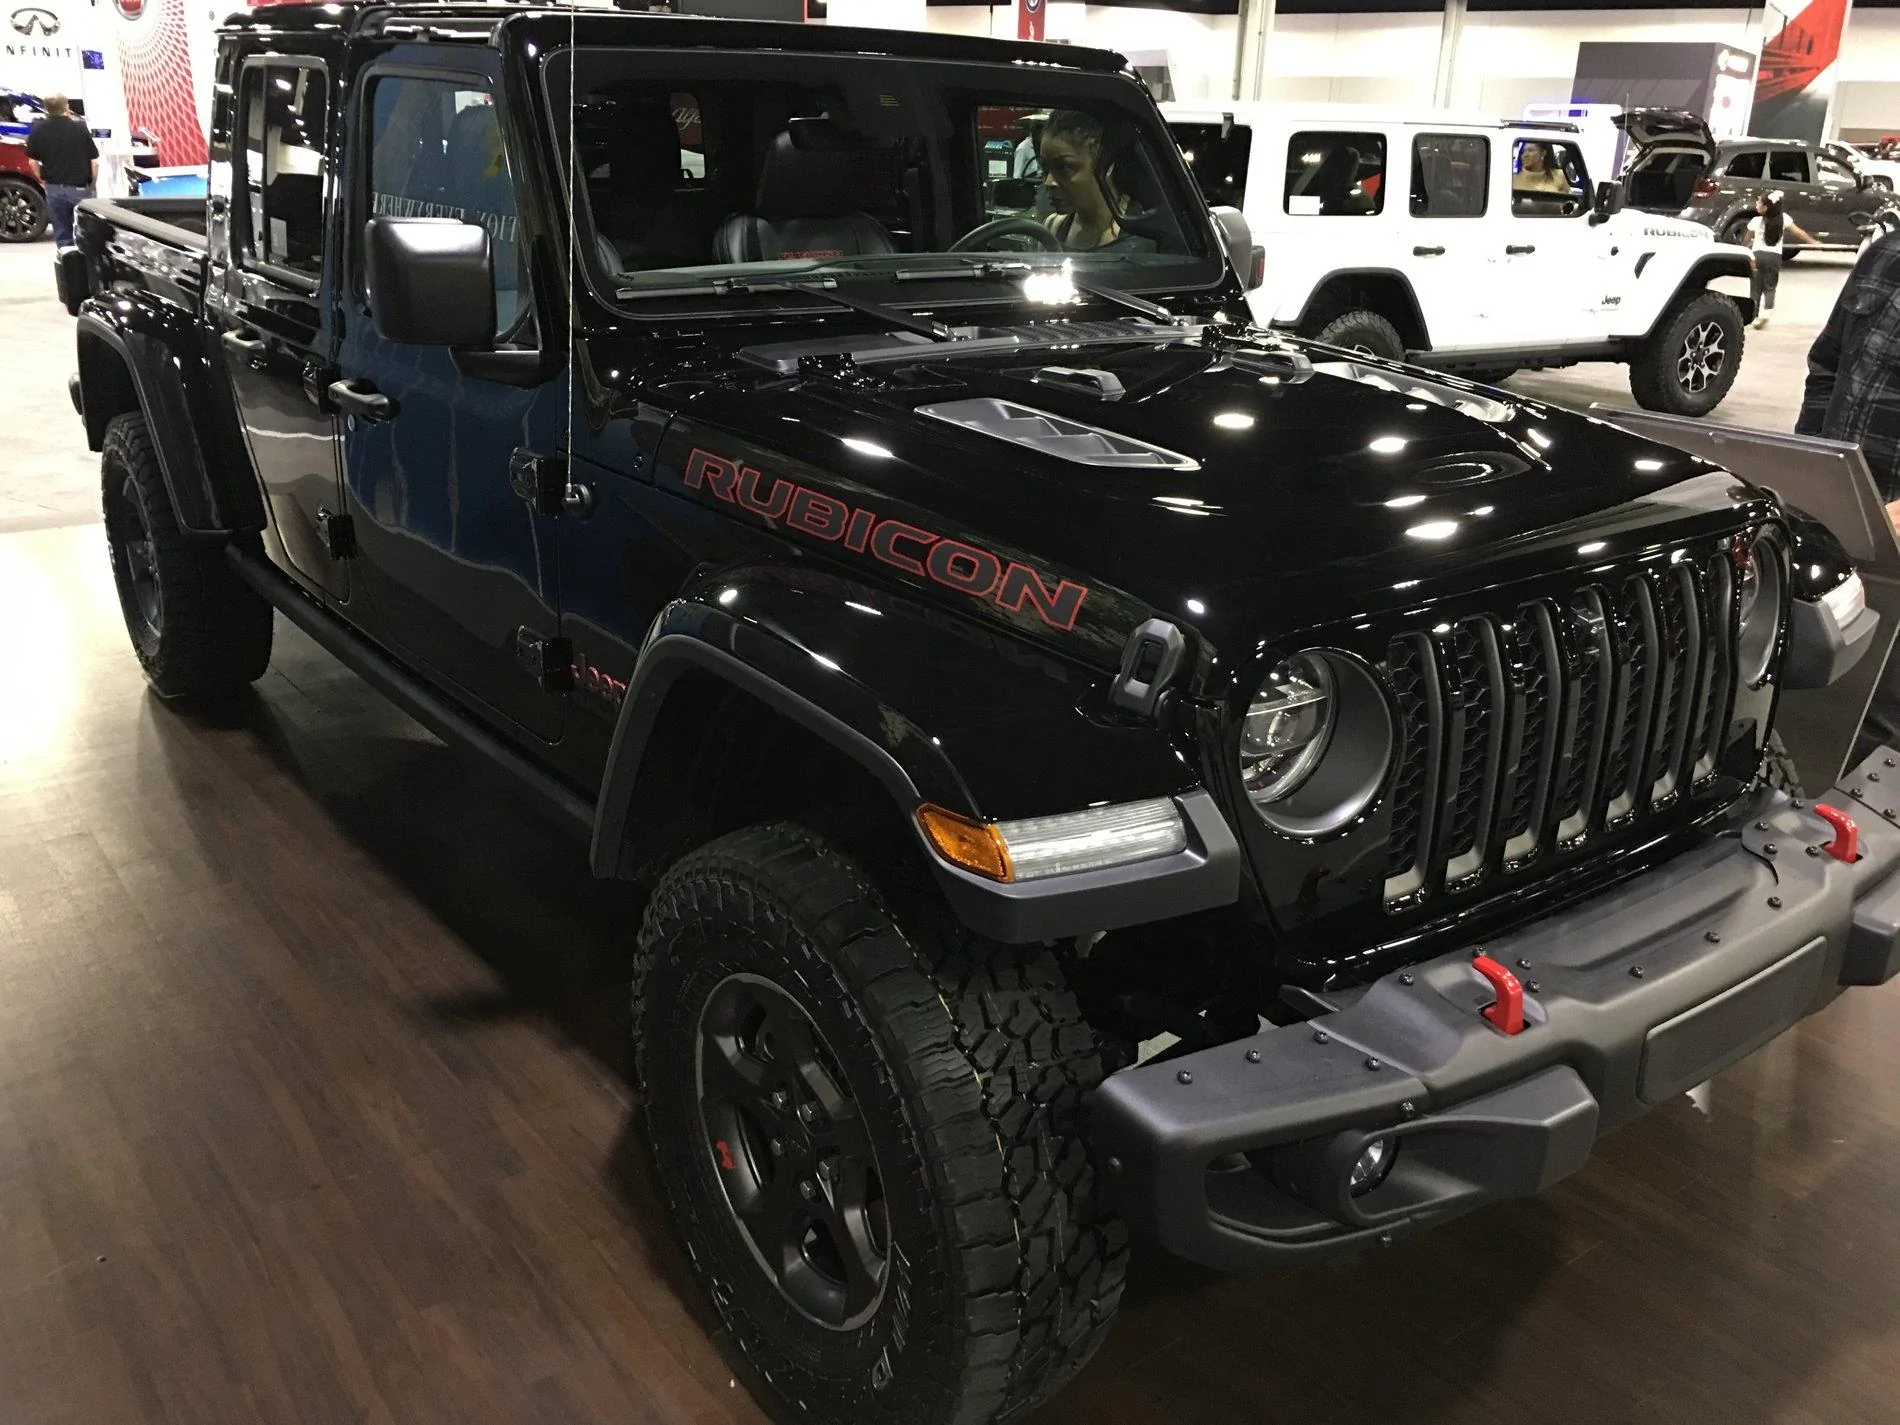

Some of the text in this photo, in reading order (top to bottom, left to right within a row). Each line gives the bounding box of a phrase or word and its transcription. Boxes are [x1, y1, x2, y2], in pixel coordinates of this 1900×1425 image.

[6, 45, 71, 57] NFINIT
[1601, 294, 1621, 306] Jeep
[683, 447, 1088, 632] RUBICON
